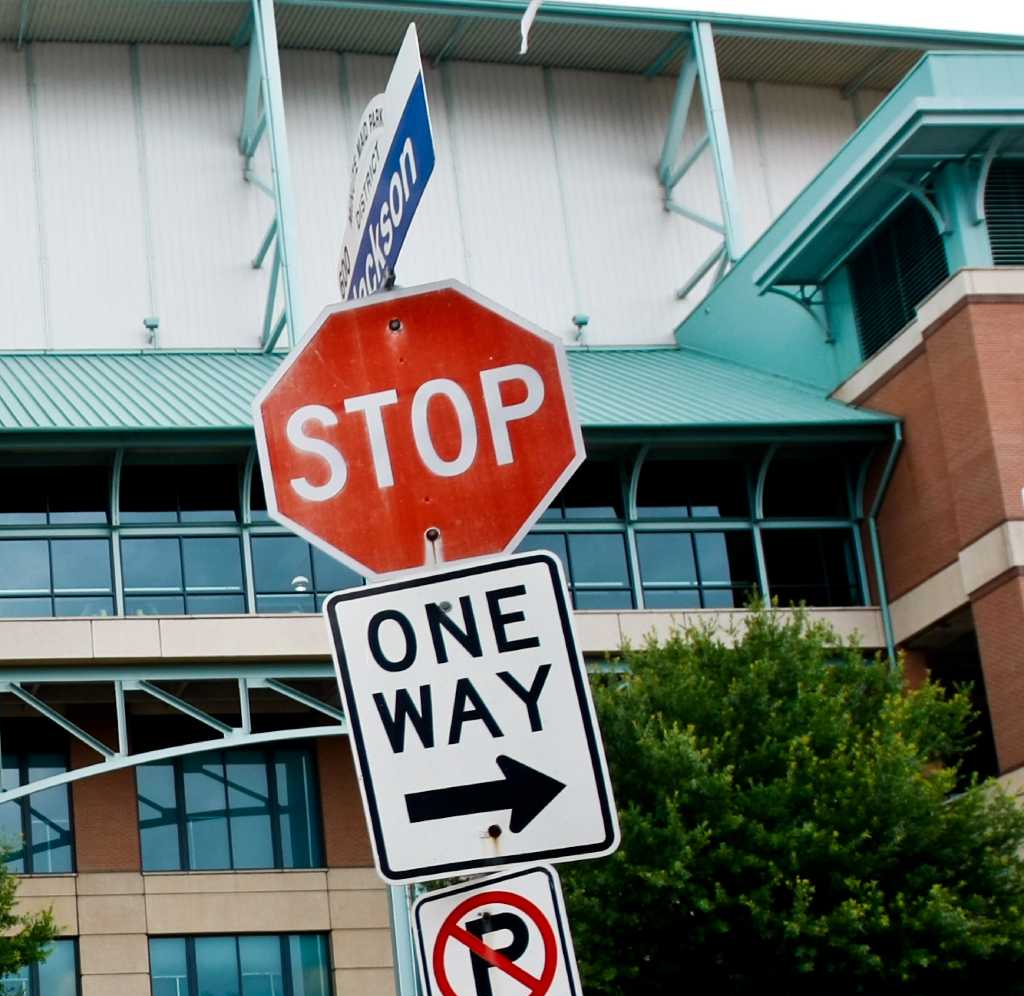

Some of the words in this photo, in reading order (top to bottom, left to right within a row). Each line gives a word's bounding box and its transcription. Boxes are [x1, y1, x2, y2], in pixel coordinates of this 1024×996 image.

[353, 137, 416, 299] ackson
[356, 140, 380, 230] DISTRICT
[286, 364, 545, 502] STOP
[368, 584, 540, 672] ONE
[372, 664, 552, 753] WAY
